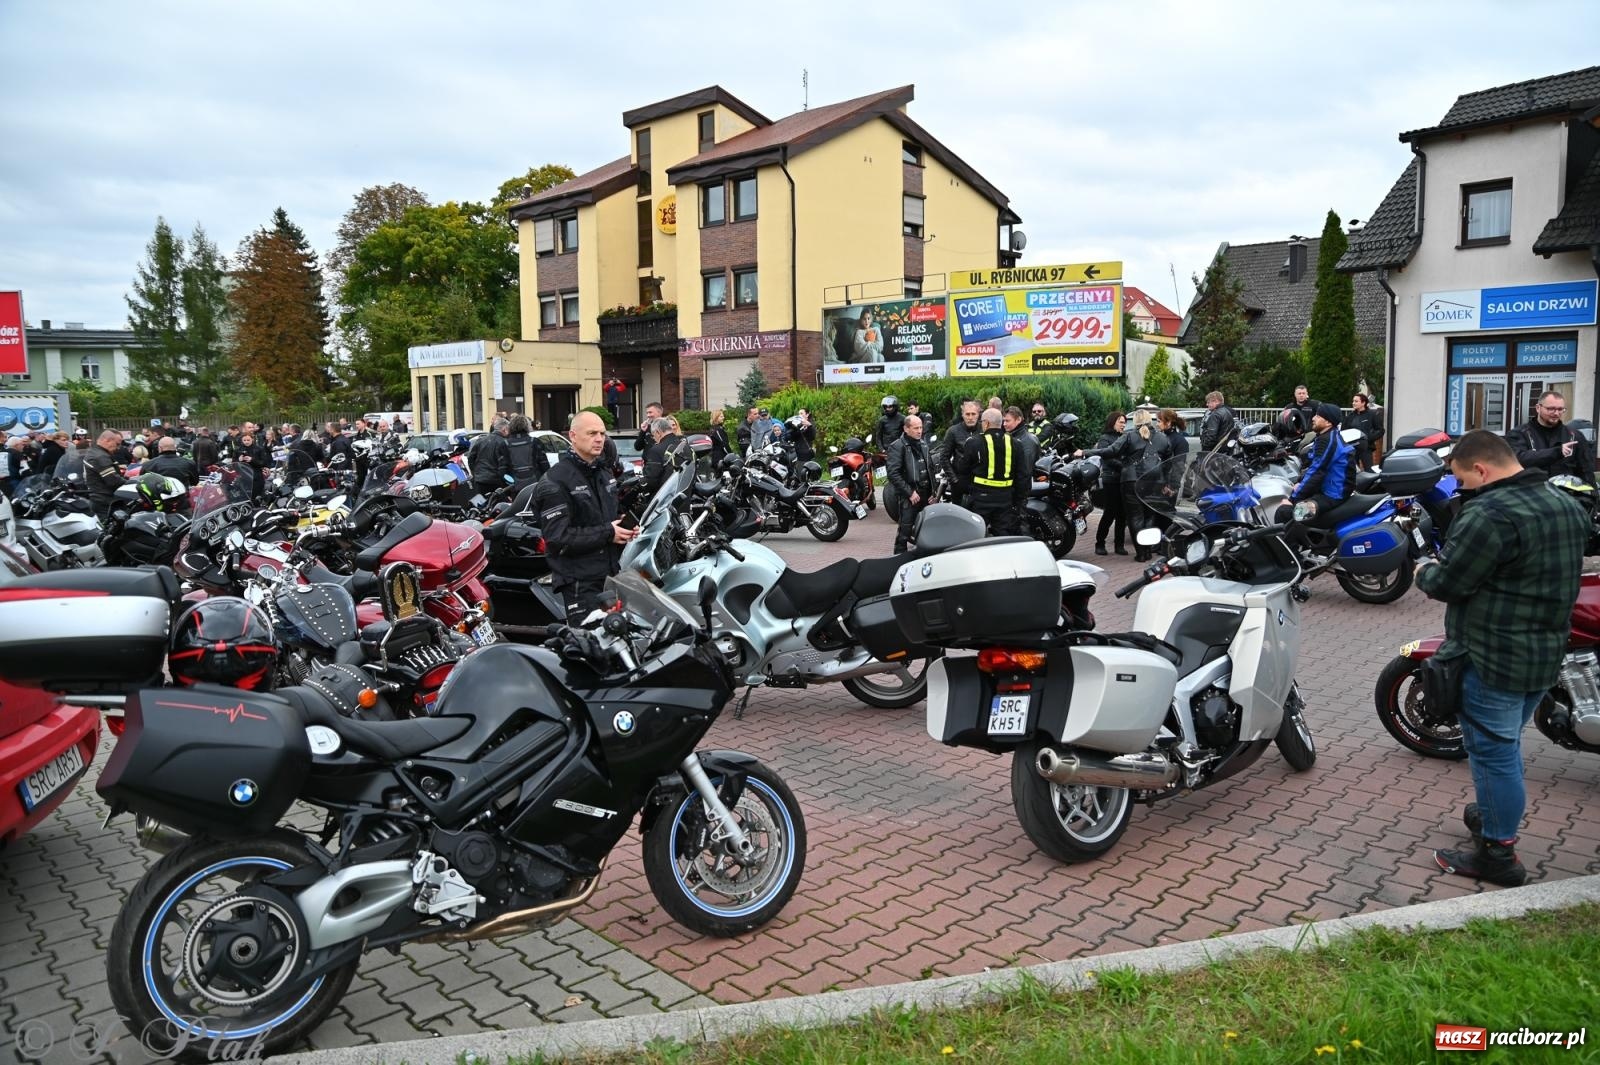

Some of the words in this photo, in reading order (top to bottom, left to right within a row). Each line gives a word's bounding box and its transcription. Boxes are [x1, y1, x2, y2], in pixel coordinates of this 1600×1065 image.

[970, 272, 988, 285] UL.
[990, 267, 1048, 284] RYBNICKA
[1051, 267, 1066, 281] 97
[1029, 290, 1112, 305] PRZECENY!
[959, 300, 994, 318] CORE
[1487, 301, 1535, 314] SALON
[1538, 297, 1588, 311] DRZWI
[1426, 309, 1473, 322] DOMEK
[898, 325, 926, 335] RELAKS
[973, 322, 998, 332] Windows
[693, 335, 762, 353] CUKIERNIA
[896, 334, 932, 344] NAGRODY
[1462, 346, 1496, 354] ROLETY
[958, 359, 1001, 370] ASUS
[1037, 356, 1103, 367] mediaexpert
[1463, 357, 1495, 365] BRAMY
[1522, 355, 1569, 363] PARAPETY
[1450, 378, 1461, 433] GERDA
[1000, 700, 1021, 712] SRC
[991, 717, 1021, 730] KH51
[29, 765, 56, 799] SRC
[55, 745, 80, 782] AR51
